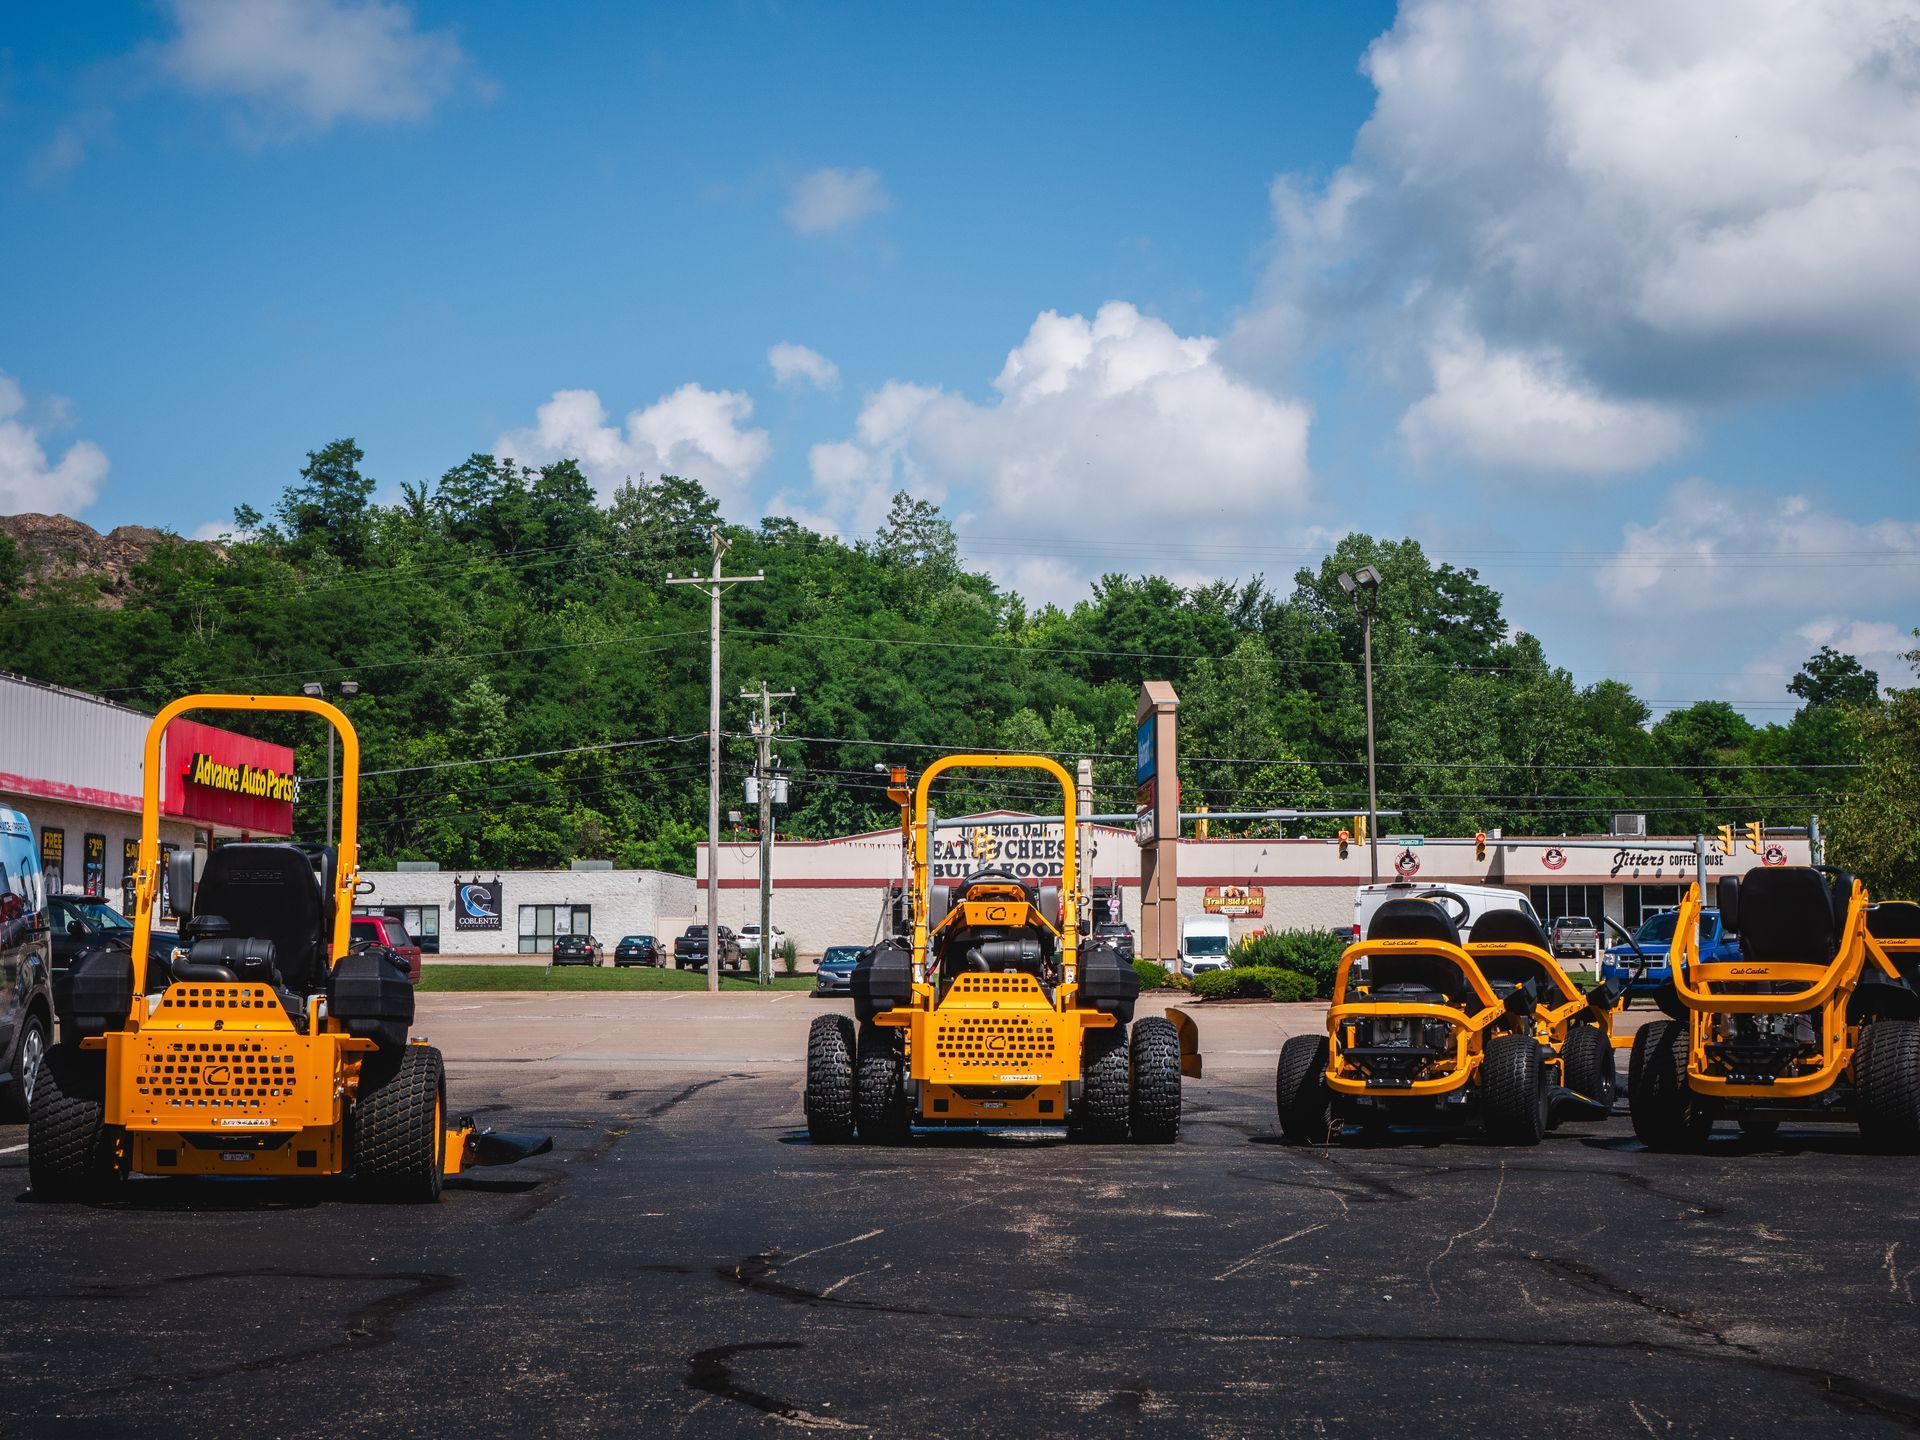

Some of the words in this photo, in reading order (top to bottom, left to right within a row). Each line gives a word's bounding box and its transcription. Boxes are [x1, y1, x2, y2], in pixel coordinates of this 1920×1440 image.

[194, 753, 240, 791] Advance
[240, 764, 266, 797] Auto
[266, 769, 293, 802] Parts
[44, 831, 63, 849] FREE
[1610, 851, 1665, 874] Jitters
[1669, 855, 1697, 866] COFFEE
[1704, 855, 1724, 866] OUSE
[1745, 967, 1769, 975] Cadet
